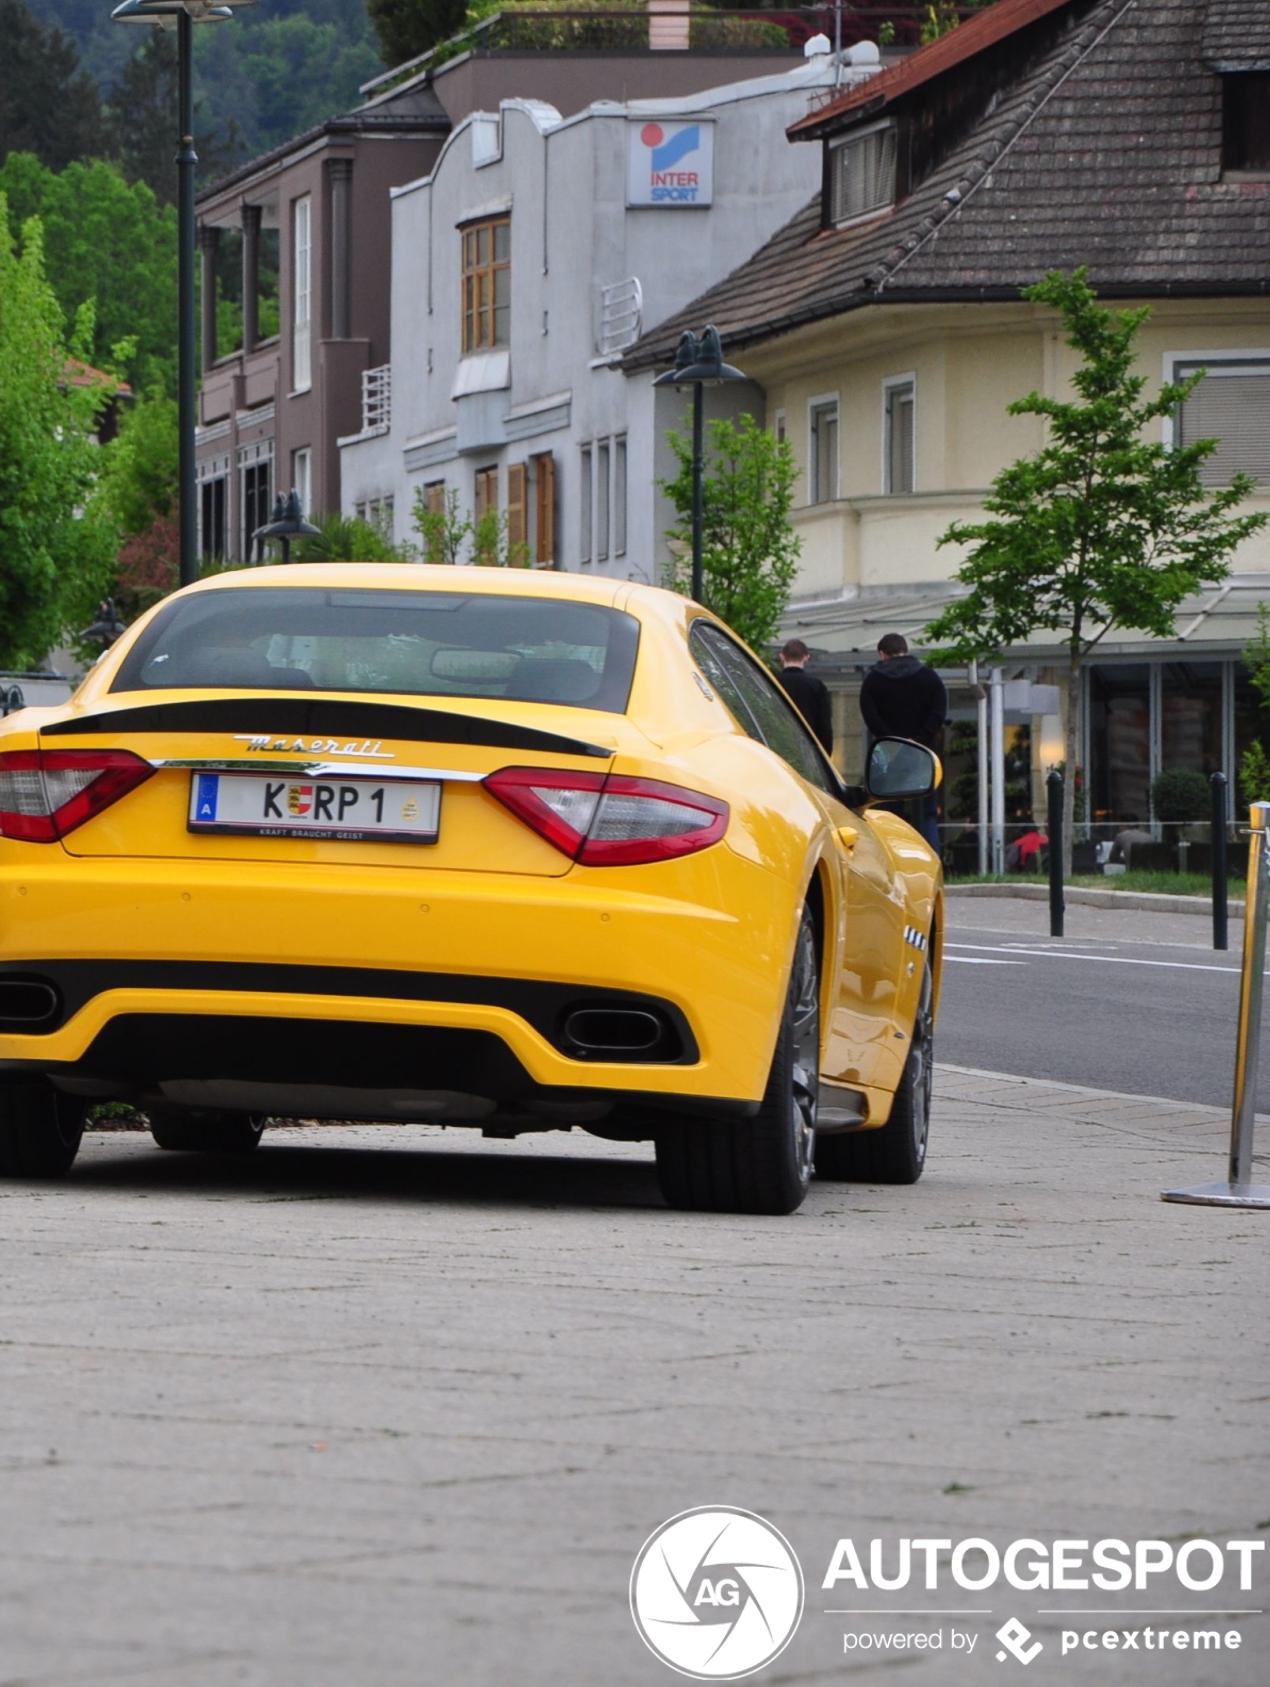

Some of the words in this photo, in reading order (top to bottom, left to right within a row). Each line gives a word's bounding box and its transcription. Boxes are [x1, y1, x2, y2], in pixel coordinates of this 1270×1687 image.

[650, 172, 699, 187] INTER
[650, 187, 699, 202] SPORT
[233, 734, 397, 759] Maserati
[200, 803, 212, 815] A
[263, 782, 286, 819] K
[370, 787, 385, 823] 1
[259, 828, 287, 836] KRAFT
[291, 830, 332, 838] BRAUCHT
[336, 832, 364, 840] GEIST
